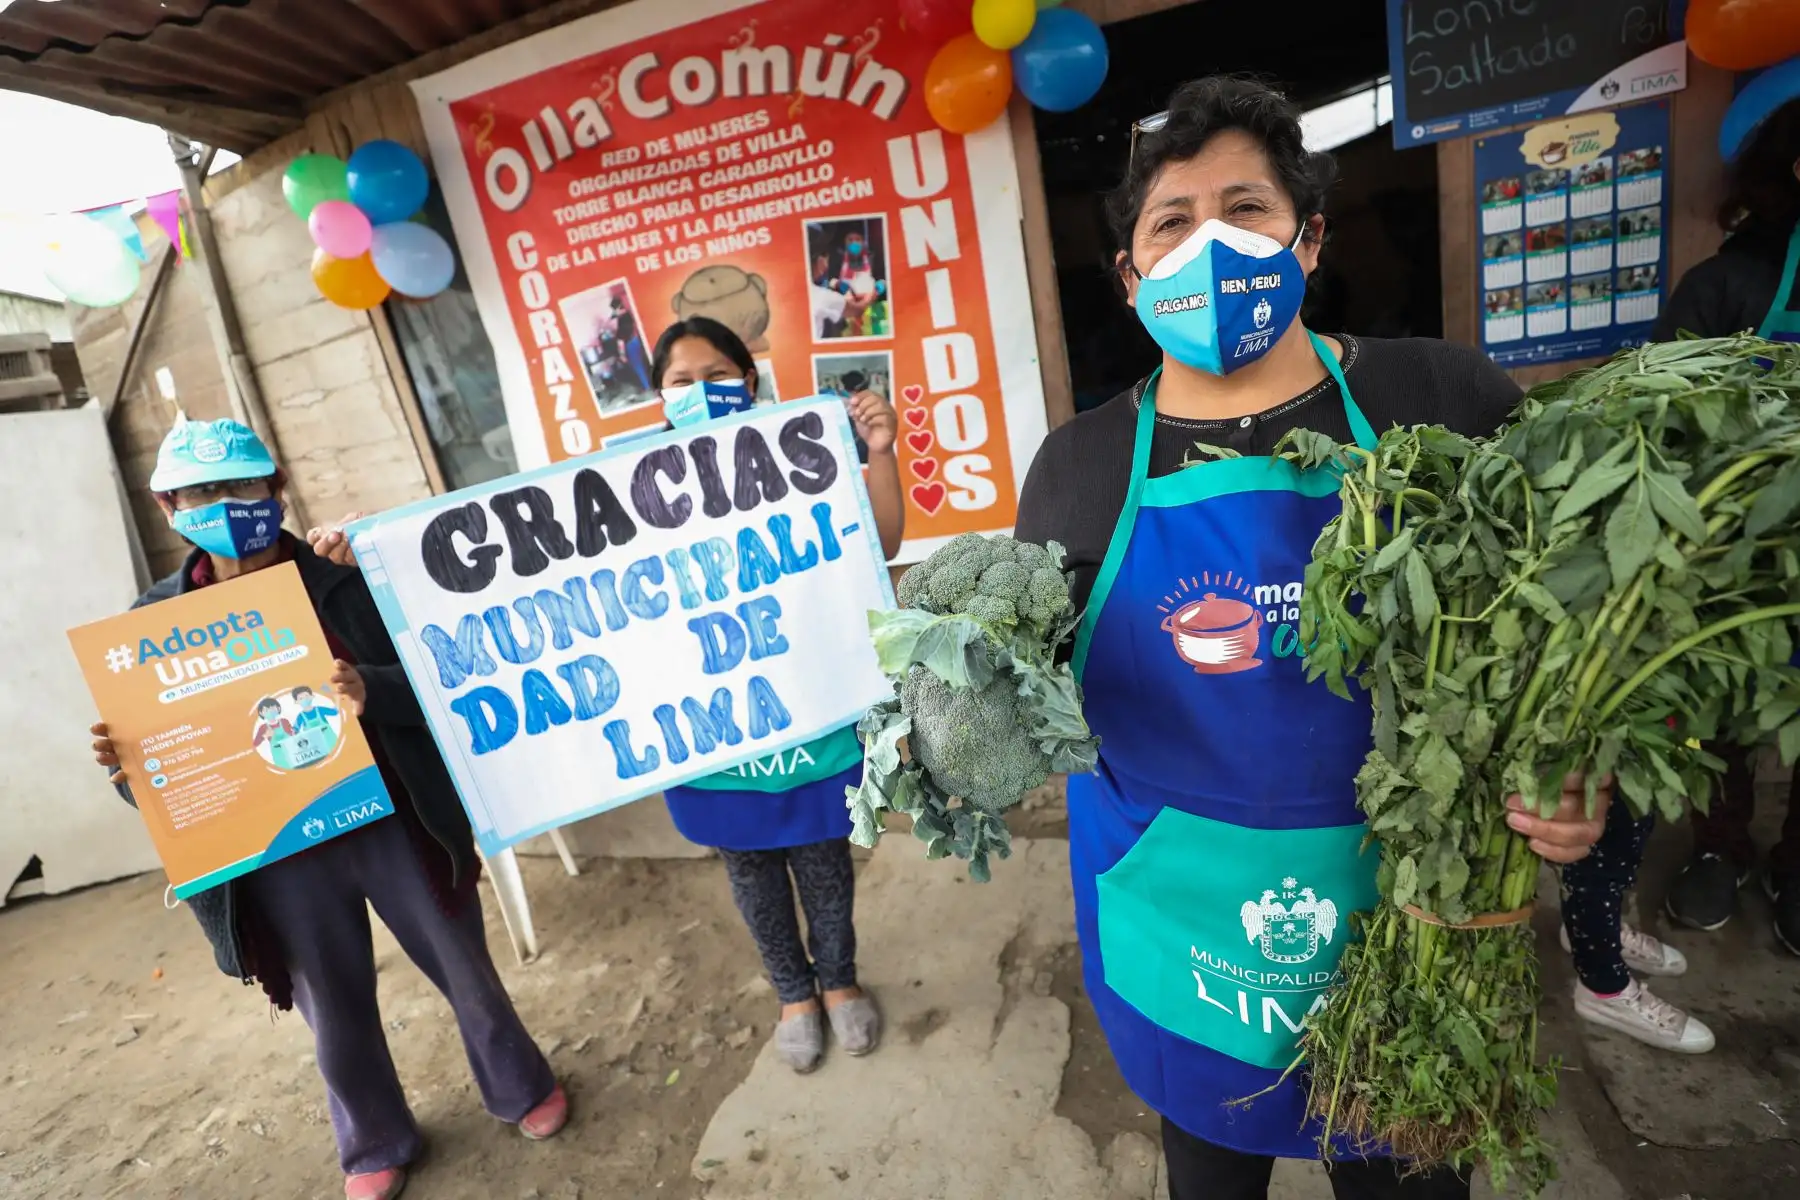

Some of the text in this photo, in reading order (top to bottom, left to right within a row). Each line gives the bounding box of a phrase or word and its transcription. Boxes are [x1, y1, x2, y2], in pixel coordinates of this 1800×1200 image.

[1630, 74, 1679, 95] LIMA
[484, 33, 910, 213] Olla Común
[601, 109, 771, 169] RED DE MUJERES
[553, 139, 835, 225] TORRE BLANCA CARABAYLLO
[568, 124, 807, 198] ORGANIZADAS DE VILLA
[545, 176, 874, 273] DE LA MUJER Y LA ALIMENTACIÓN
[566, 163, 835, 246] DRECHO PARA DESARROLLO
[635, 226, 773, 274] DE LOS NIÑOS
[1221, 278, 1250, 294] BIEN,
[1250, 272, 1281, 291] PERÚ!
[506, 230, 593, 456] CORAZO
[1234, 336, 1270, 358] LIMA
[421, 410, 839, 594] GRACIAS
[420, 501, 860, 690] MUNICIPALI-
[1266, 603, 1300, 623] a la
[104, 609, 265, 674] #Adopta
[154, 625, 298, 687] UnaOlla
[687, 594, 790, 675] DE
[180, 648, 303, 696] MUNICIPALIDAD DE LIMA
[450, 654, 621, 757] DAD
[603, 676, 793, 780] LIMA
[295, 749, 322, 764] LIMA
[721, 746, 816, 777] IMA
[334, 801, 385, 829] LIMA
[1190, 944, 1345, 986] MUNICIPALIDA
[1192, 970, 1330, 1034] LIM
